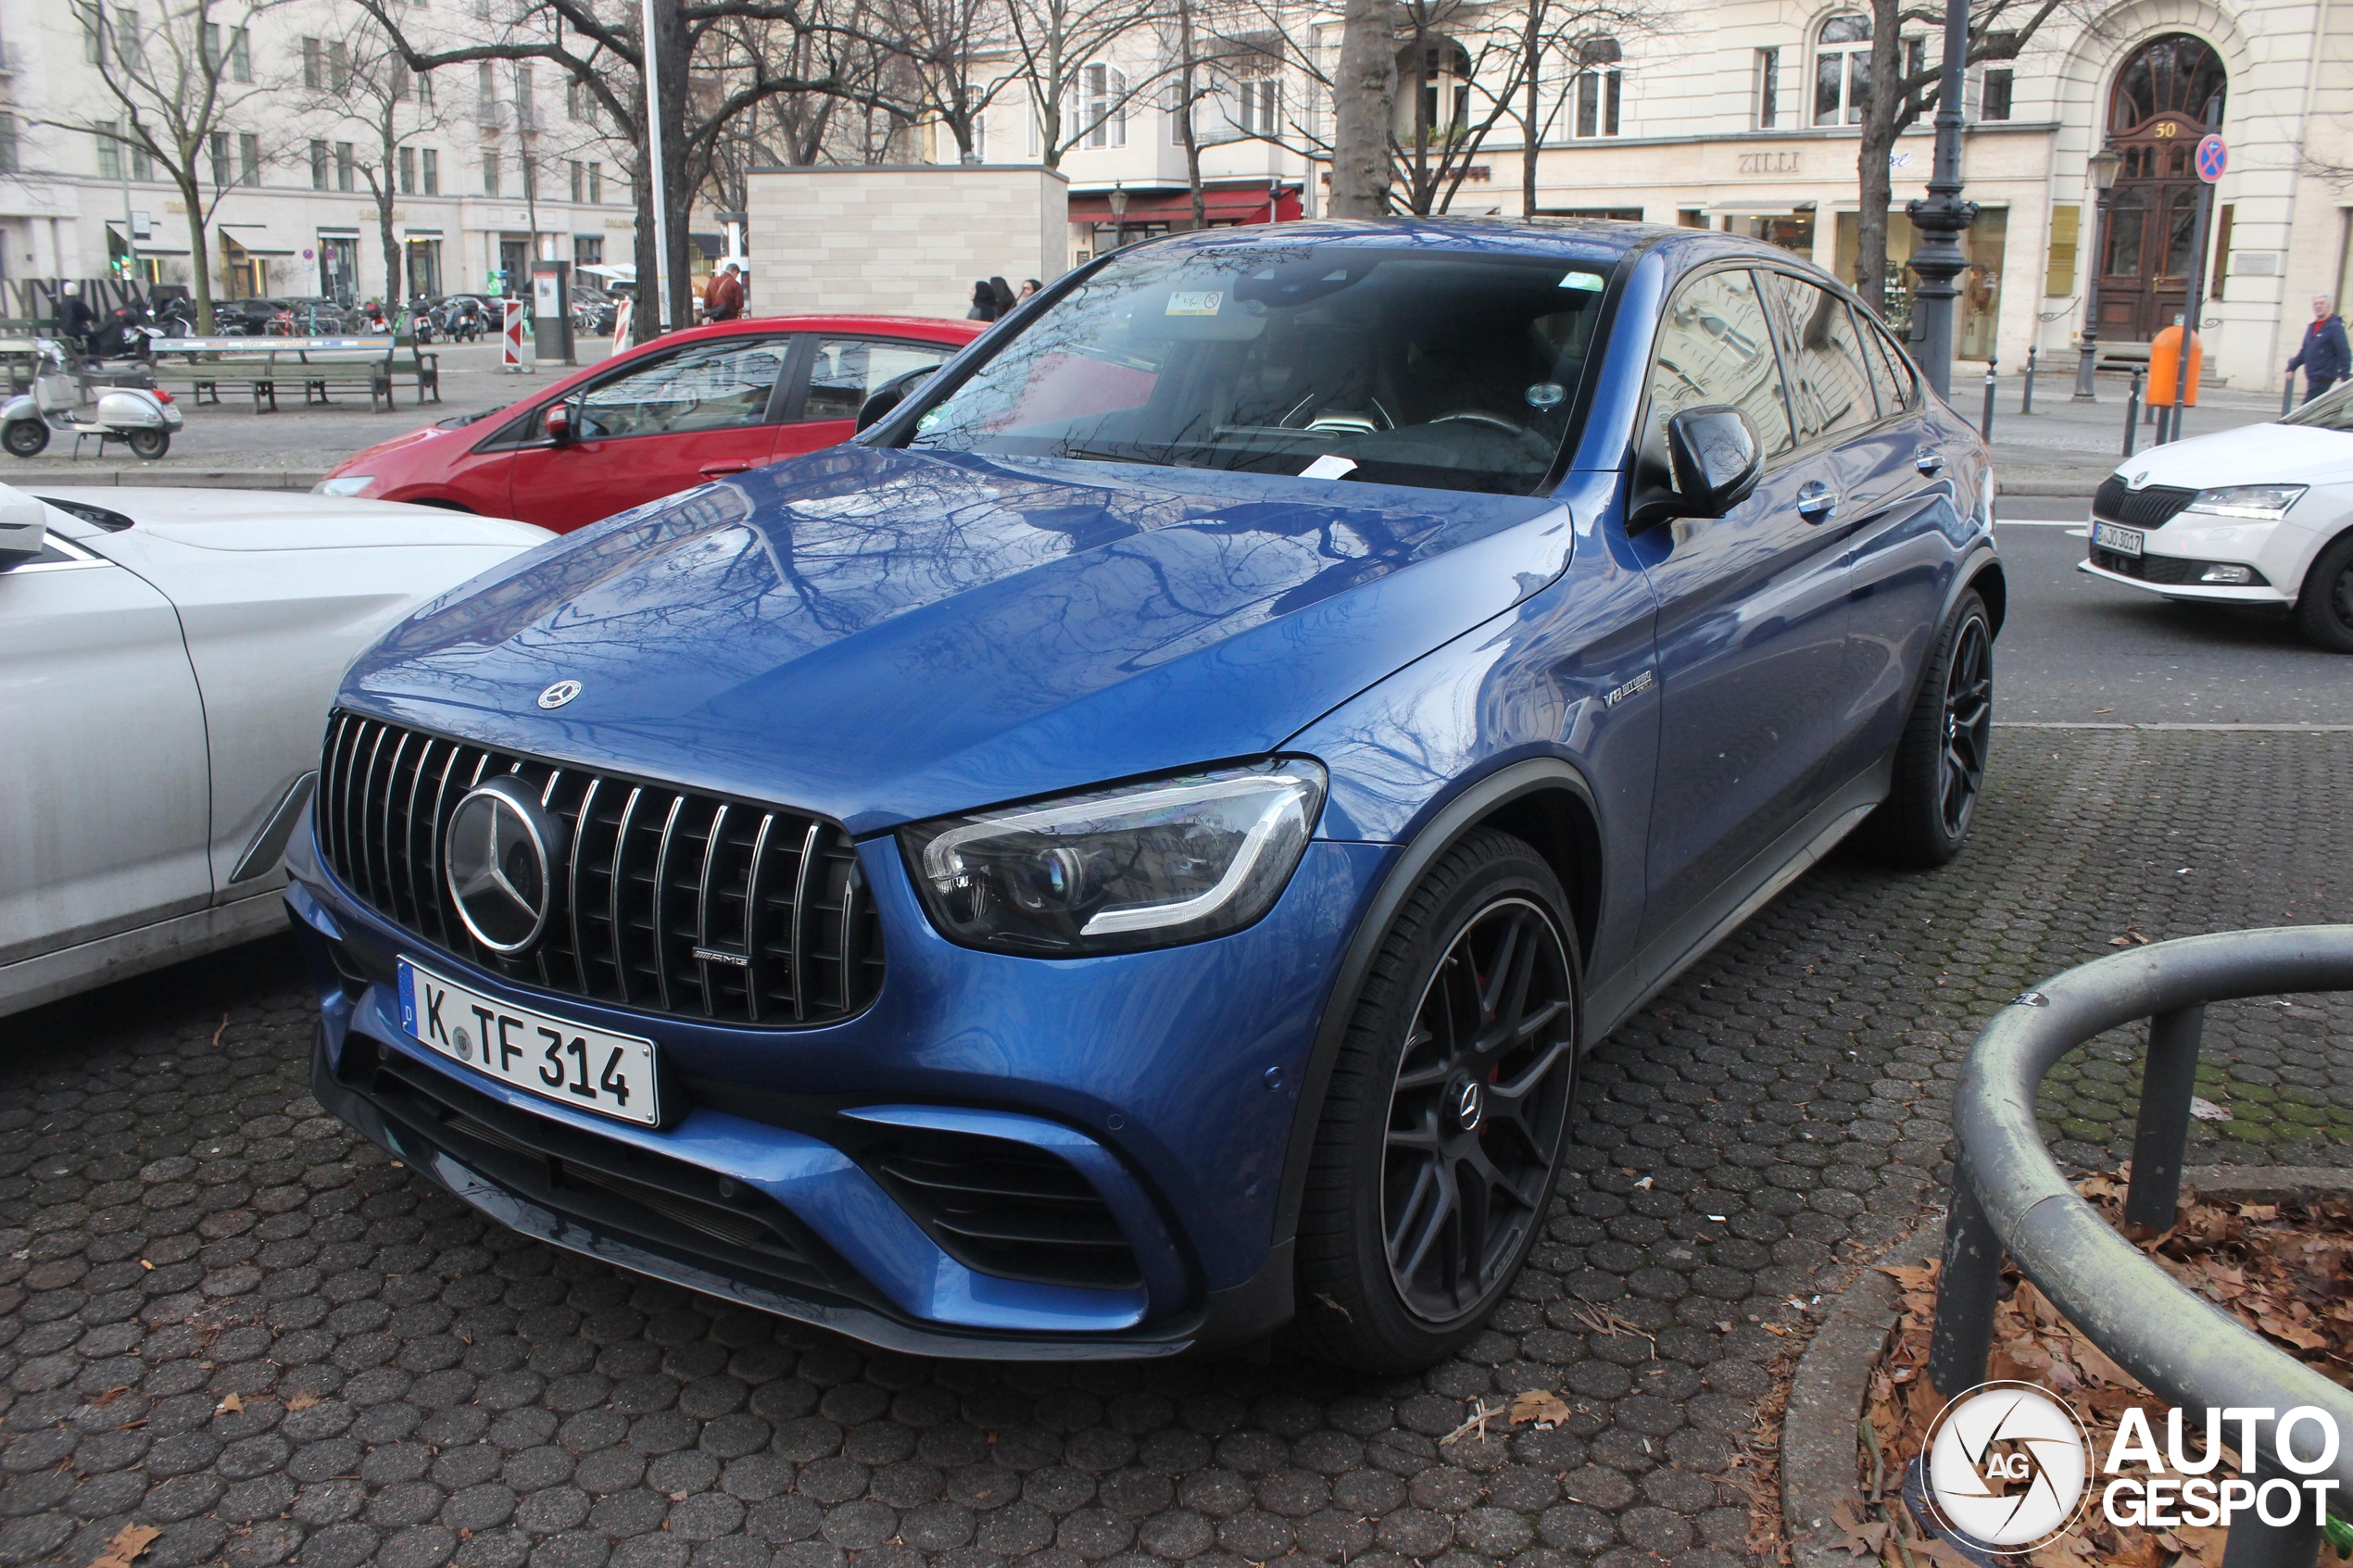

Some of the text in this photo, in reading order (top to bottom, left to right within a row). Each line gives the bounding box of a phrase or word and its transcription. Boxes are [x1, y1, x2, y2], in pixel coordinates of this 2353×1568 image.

[2155, 123, 2176, 138] 50
[1738, 151, 1801, 173] ZILLI
[2097, 526, 2103, 542] B
[2119, 532, 2141, 551] 3017
[1603, 687, 1622, 709] V8
[1621, 670, 1652, 695] BITURBO
[709, 953, 749, 966] AMG
[405, 1004, 413, 1022] D
[425, 982, 630, 1107] K TF 314
